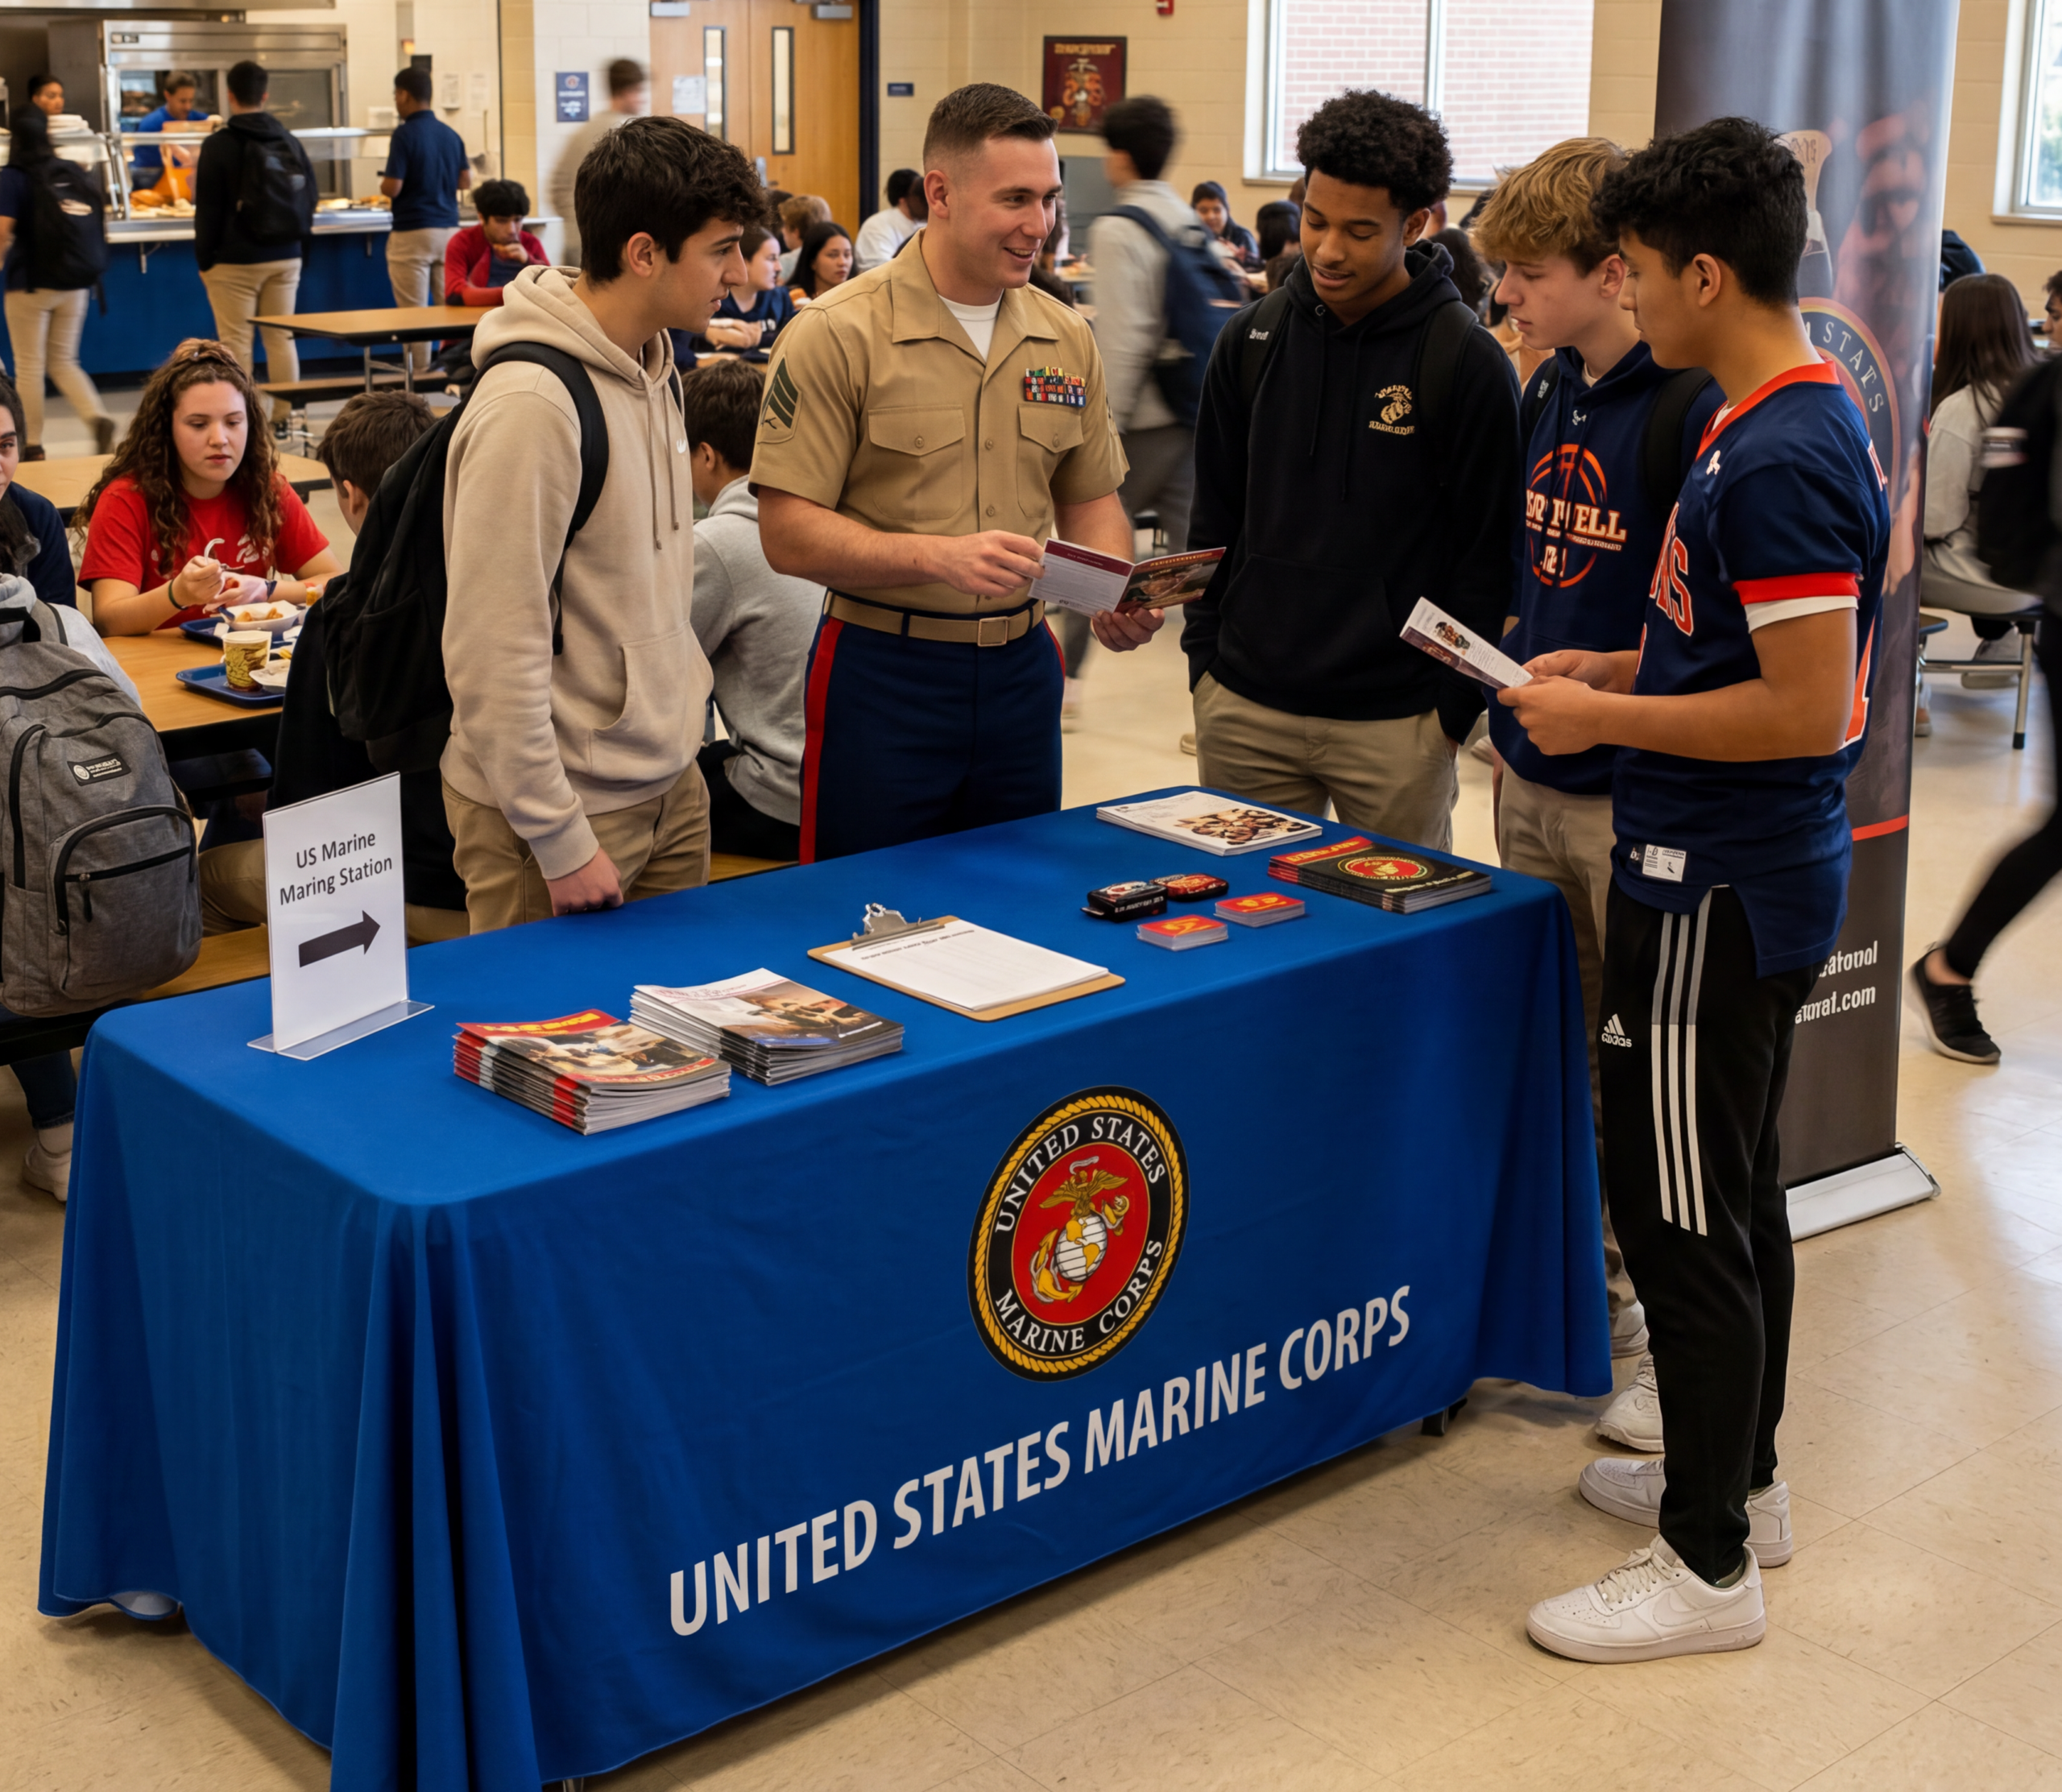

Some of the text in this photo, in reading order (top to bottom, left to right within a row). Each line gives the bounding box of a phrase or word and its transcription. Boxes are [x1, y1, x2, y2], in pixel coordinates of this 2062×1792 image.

[279, 857, 393, 906] Maring Station
[296, 833, 376, 869] US Marine
[994, 1115, 1166, 1233] UNITED STATES
[995, 1240, 1163, 1353] MARINE CORPS
[669, 1285, 1411, 1637] UNITED STATES MARINE CORPS
